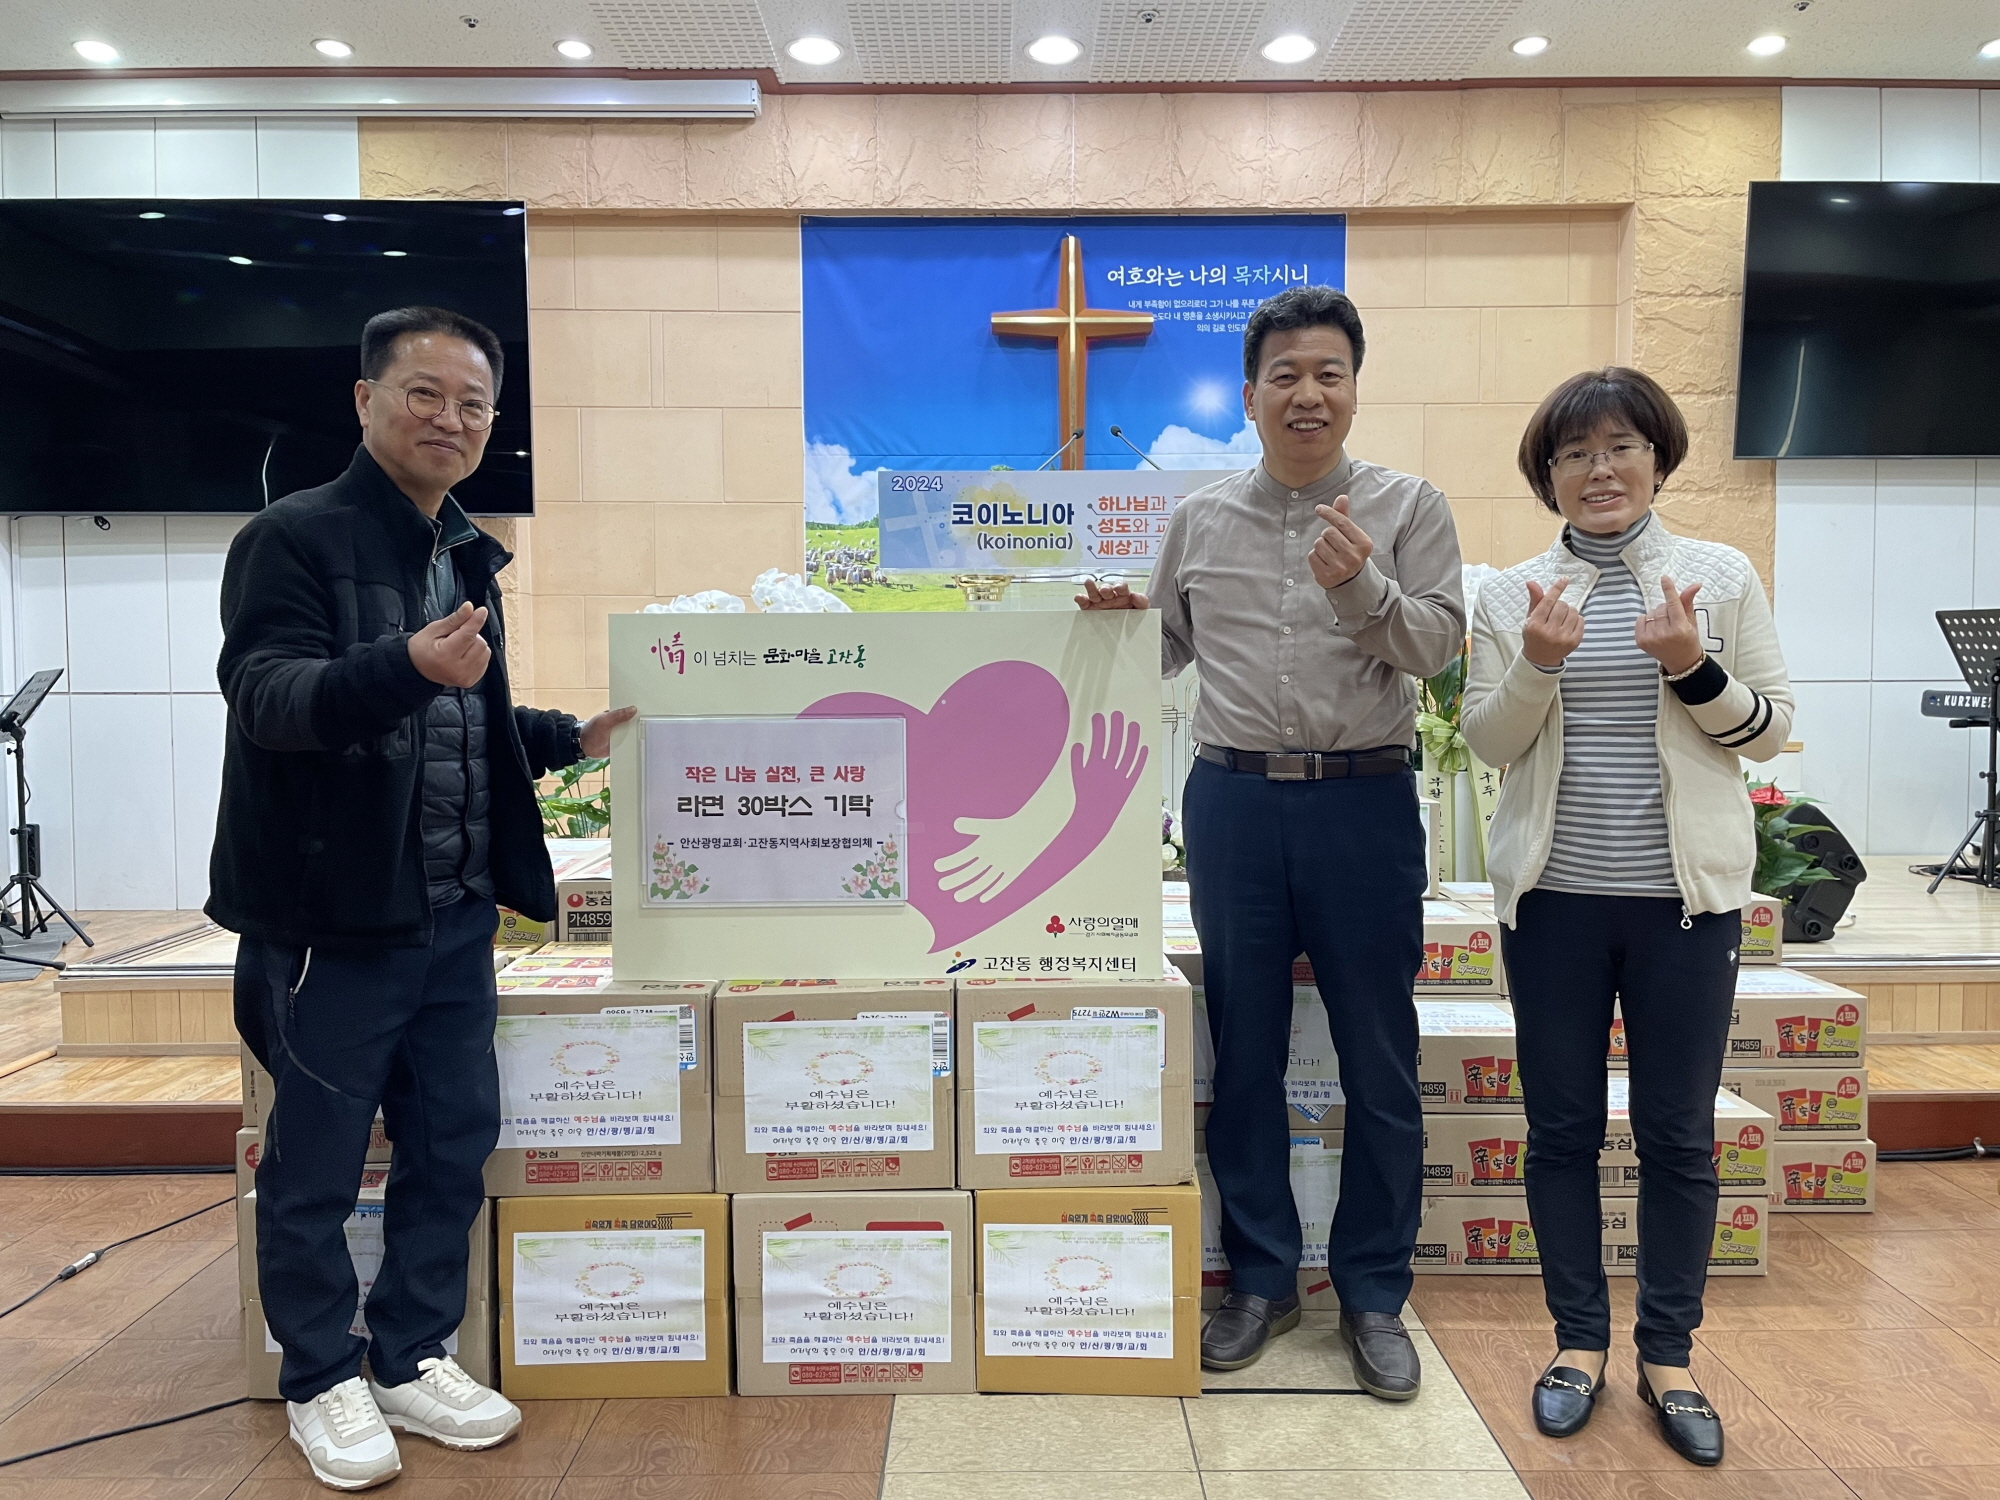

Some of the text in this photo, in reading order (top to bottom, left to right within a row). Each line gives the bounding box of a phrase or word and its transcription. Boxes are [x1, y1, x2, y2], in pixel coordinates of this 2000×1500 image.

[1107, 263, 1309, 287] 여호와는 나의 목자시니
[1128, 300, 1142, 309] 내게
[1144, 300, 1172, 309] 부족함이
[1174, 300, 1208, 309] 없으리로다
[1209, 300, 1224, 309] 그가
[1225, 300, 1239, 309] 나를
[1241, 300, 1256, 309] 푸른
[1174, 312, 1180, 321] 내
[1182, 312, 1203, 321] 영혼을
[1205, 312, 1246, 321] 소생시키시고
[1196, 324, 1210, 333] 의의
[1212, 324, 1226, 333] 길로
[892, 475, 944, 492] 2024
[1098, 496, 1168, 512] 하나님과
[951, 502, 1075, 526] 코이노니아
[1098, 518, 1149, 534] 성도와
[977, 532, 1074, 551] (koinonia)
[1097, 540, 1149, 556] 세상과
[650, 631, 867, 675] 情 이 넘치는 문화마을 고잔동
[685, 766, 866, 783] 작은 나눔 실천, 큰 사랑
[1428, 777, 1443, 799] 부활
[676, 794, 874, 818] 라면 30박스 기탁
[585, 895, 612, 906] 농심
[569, 912, 612, 926] 가4859
[1068, 916, 1139, 932] 사랑의열매
[1752, 913, 1770, 924] 4팩
[501, 930, 542, 942] 짜파게티
[1470, 938, 1489, 950] 4팩
[983, 956, 1136, 972] 고잔동 행정복지센터
[1836, 1011, 1856, 1022] 4팩
[1733, 1040, 1760, 1050] 가4859
[1467, 1064, 1482, 1090] 辛
[554, 1080, 616, 1090] 예수님은
[1838, 1083, 1857, 1095] 4팩
[529, 1090, 642, 1102] 부활하셨습니다!
[809, 1090, 870, 1099] 예수님은
[1038, 1089, 1099, 1098] 예수님은
[785, 1100, 896, 1111] 부활하셨습니다!
[1014, 1099, 1124, 1111] 부활하셨습니다!
[516, 1117, 537, 1125] 죽음을
[541, 1117, 570, 1125] 해결하신
[574, 1116, 606, 1124] 예수님을
[610, 1115, 639, 1123] 바라보며
[643, 1115, 674, 1123] 힘내세요!
[796, 1125, 825, 1133] 해결하신
[1001, 1126, 1022, 1134] 죽음을
[1093, 1124, 1121, 1132] 바라보며
[1125, 1124, 1155, 1132] 힘내세요!
[1740, 1133, 1762, 1146] 4팩
[538, 1150, 558, 1158] 농심
[1474, 1147, 1489, 1172] 辛
[1724, 1162, 1762, 1175] 짜파게티
[1844, 1158, 1864, 1170] 4팩
[538, 1170, 578, 1178] 080-023-5181
[1734, 1213, 1756, 1226] 4팩
[1468, 1226, 1483, 1252] 辛
[1416, 1246, 1446, 1256] 가4859
[1718, 1242, 1756, 1255] 짜파게티
[579, 1303, 640, 1311] 예수님은
[828, 1302, 888, 1310] 예수님은
[1048, 1297, 1109, 1306] 예수님은
[555, 1311, 667, 1322] 부활하셨습니다!
[803, 1312, 914, 1322] 부활하셨습니다!
[1024, 1307, 1135, 1316] 부활하셨습니다!
[567, 1337, 595, 1345] 해결하신
[599, 1336, 631, 1344] 예수님을
[667, 1334, 699, 1342] 힘내세요!
[789, 1336, 810, 1344] 죽음을
[814, 1336, 843, 1344] 해결하신
[846, 1336, 878, 1344] 예수님을
[882, 1336, 910, 1344] 바라보며
[914, 1336, 945, 1344] 힘내세요!
[1068, 1329, 1099, 1338] 예수님을
[1103, 1330, 1132, 1338] 바라보며
[1135, 1331, 1166, 1339] 힘내세요!
